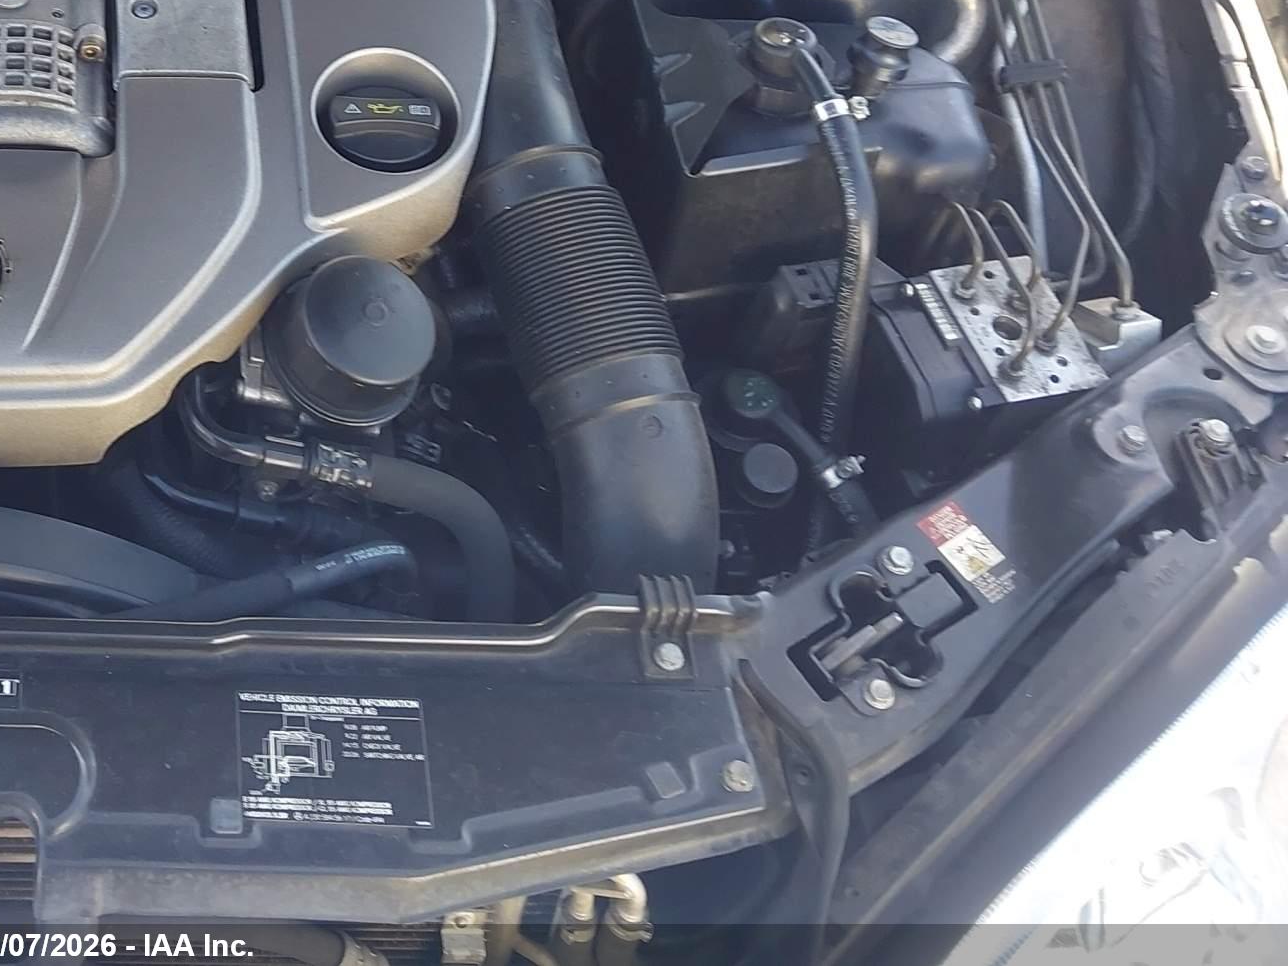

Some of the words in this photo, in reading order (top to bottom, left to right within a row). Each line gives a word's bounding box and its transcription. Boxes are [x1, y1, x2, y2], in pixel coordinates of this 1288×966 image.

[238, 692, 275, 703] VEHICLE
[275, 694, 318, 704] EMISSION
[318, 696, 359, 706] CONTROL
[359, 698, 420, 709] INFORMATION
[363, 707, 379, 716] AG
